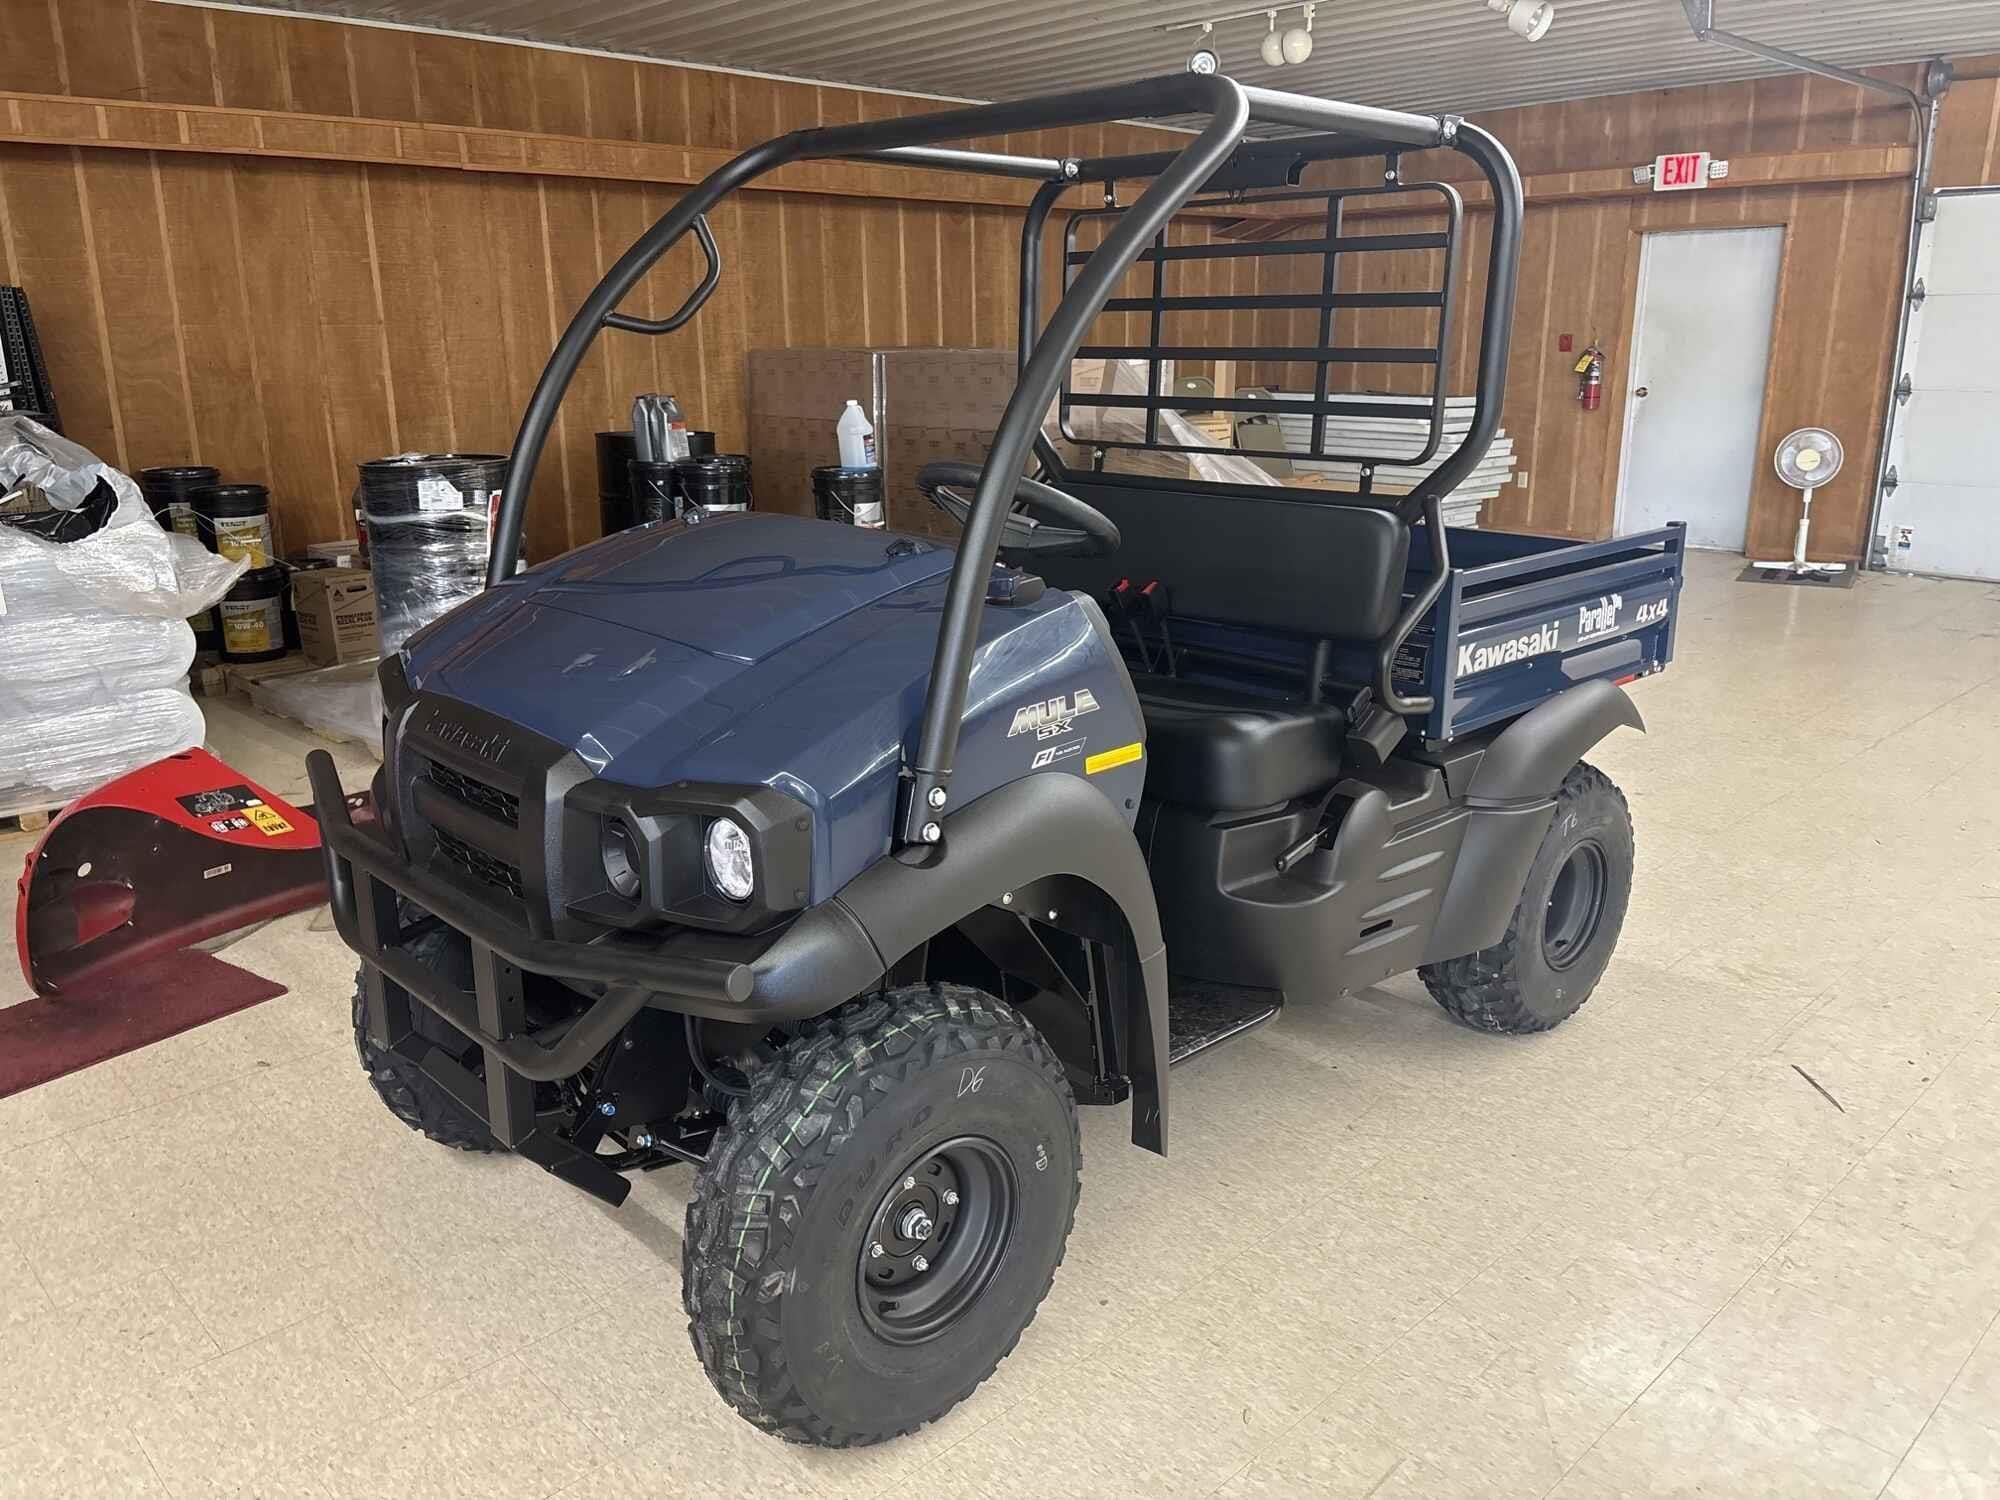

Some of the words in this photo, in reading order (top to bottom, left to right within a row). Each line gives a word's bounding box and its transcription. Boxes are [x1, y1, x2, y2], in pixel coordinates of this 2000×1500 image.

[1663, 154, 1701, 185] EXIT
[1635, 597, 1669, 623] 4x4
[1456, 620, 1560, 677] Kawasaki
[1007, 688, 1100, 737] MULE
[1037, 717, 1074, 741] SX
[1034, 748, 1055, 767] FI
[957, 1065, 987, 1098] D6
